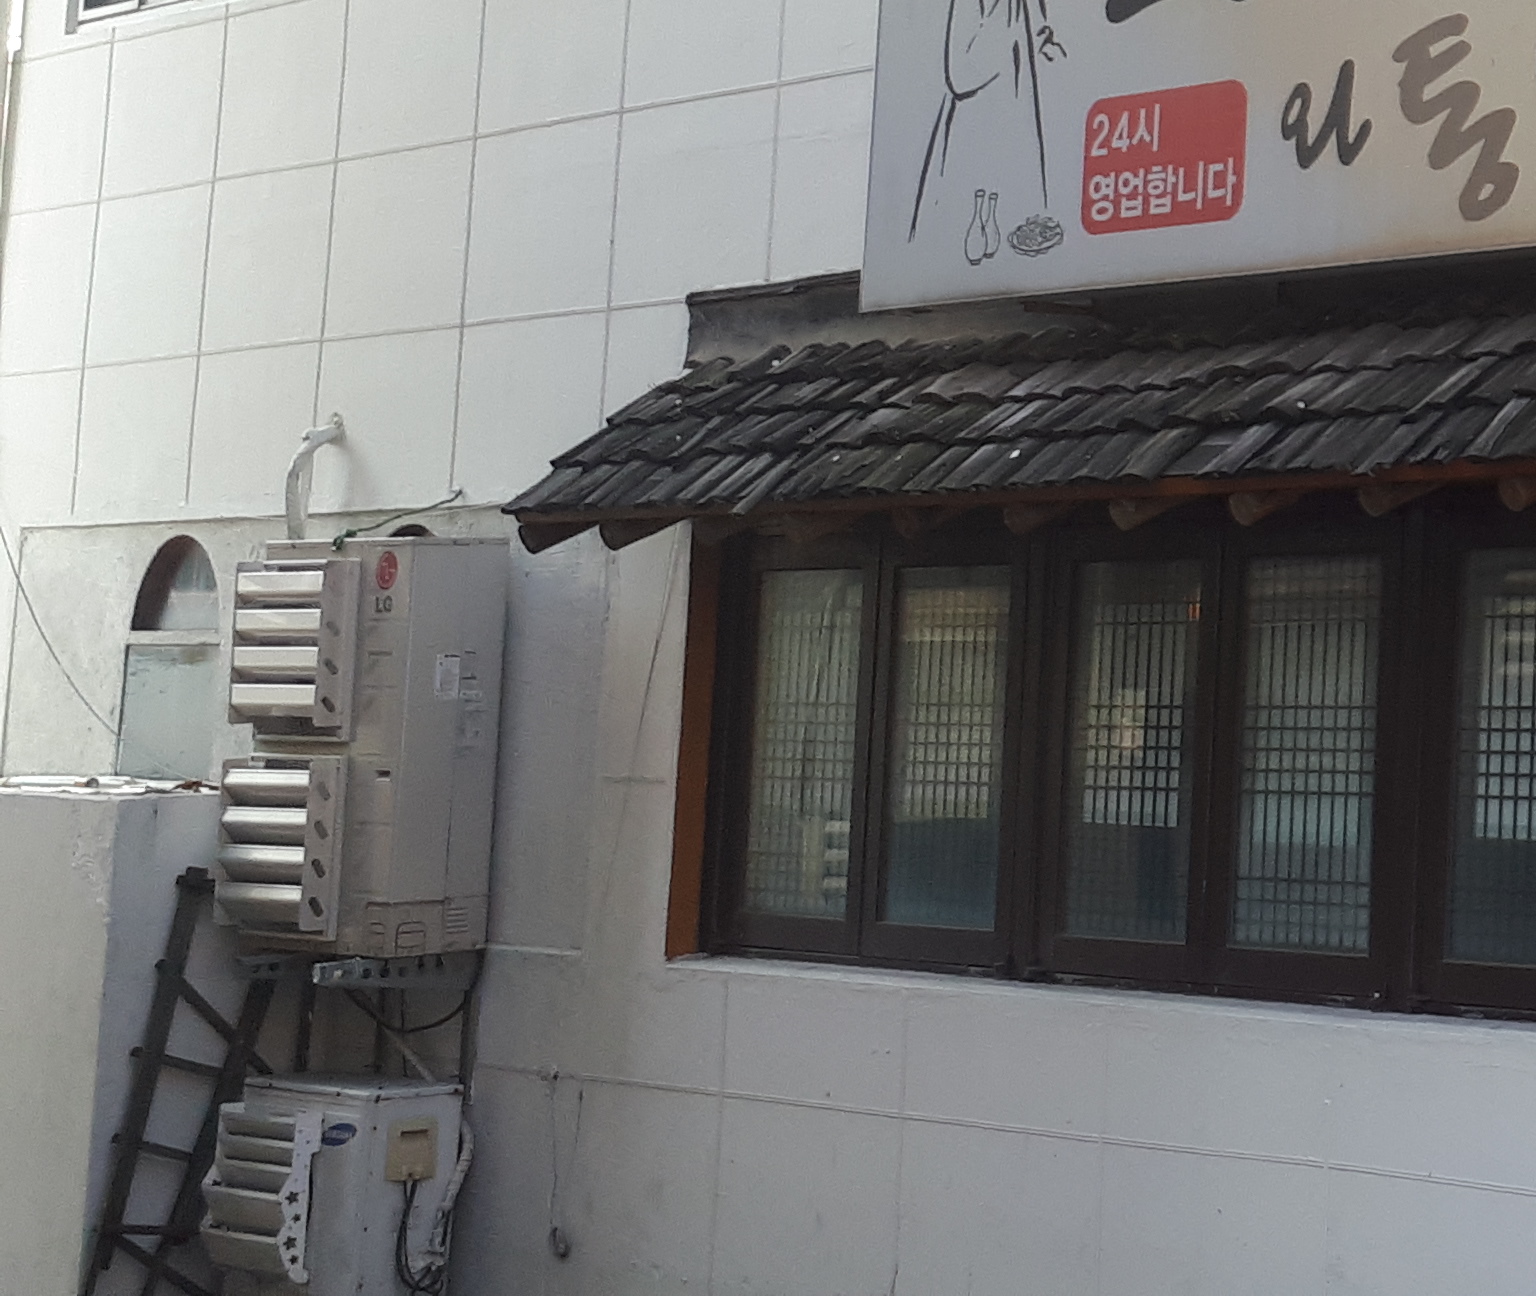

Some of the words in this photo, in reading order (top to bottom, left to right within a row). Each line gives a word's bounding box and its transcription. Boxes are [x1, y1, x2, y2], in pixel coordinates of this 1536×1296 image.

[1090, 112, 1161, 155] 24시
[1088, 159, 1239, 221] 영업합니다
[375, 595, 393, 613] LG
